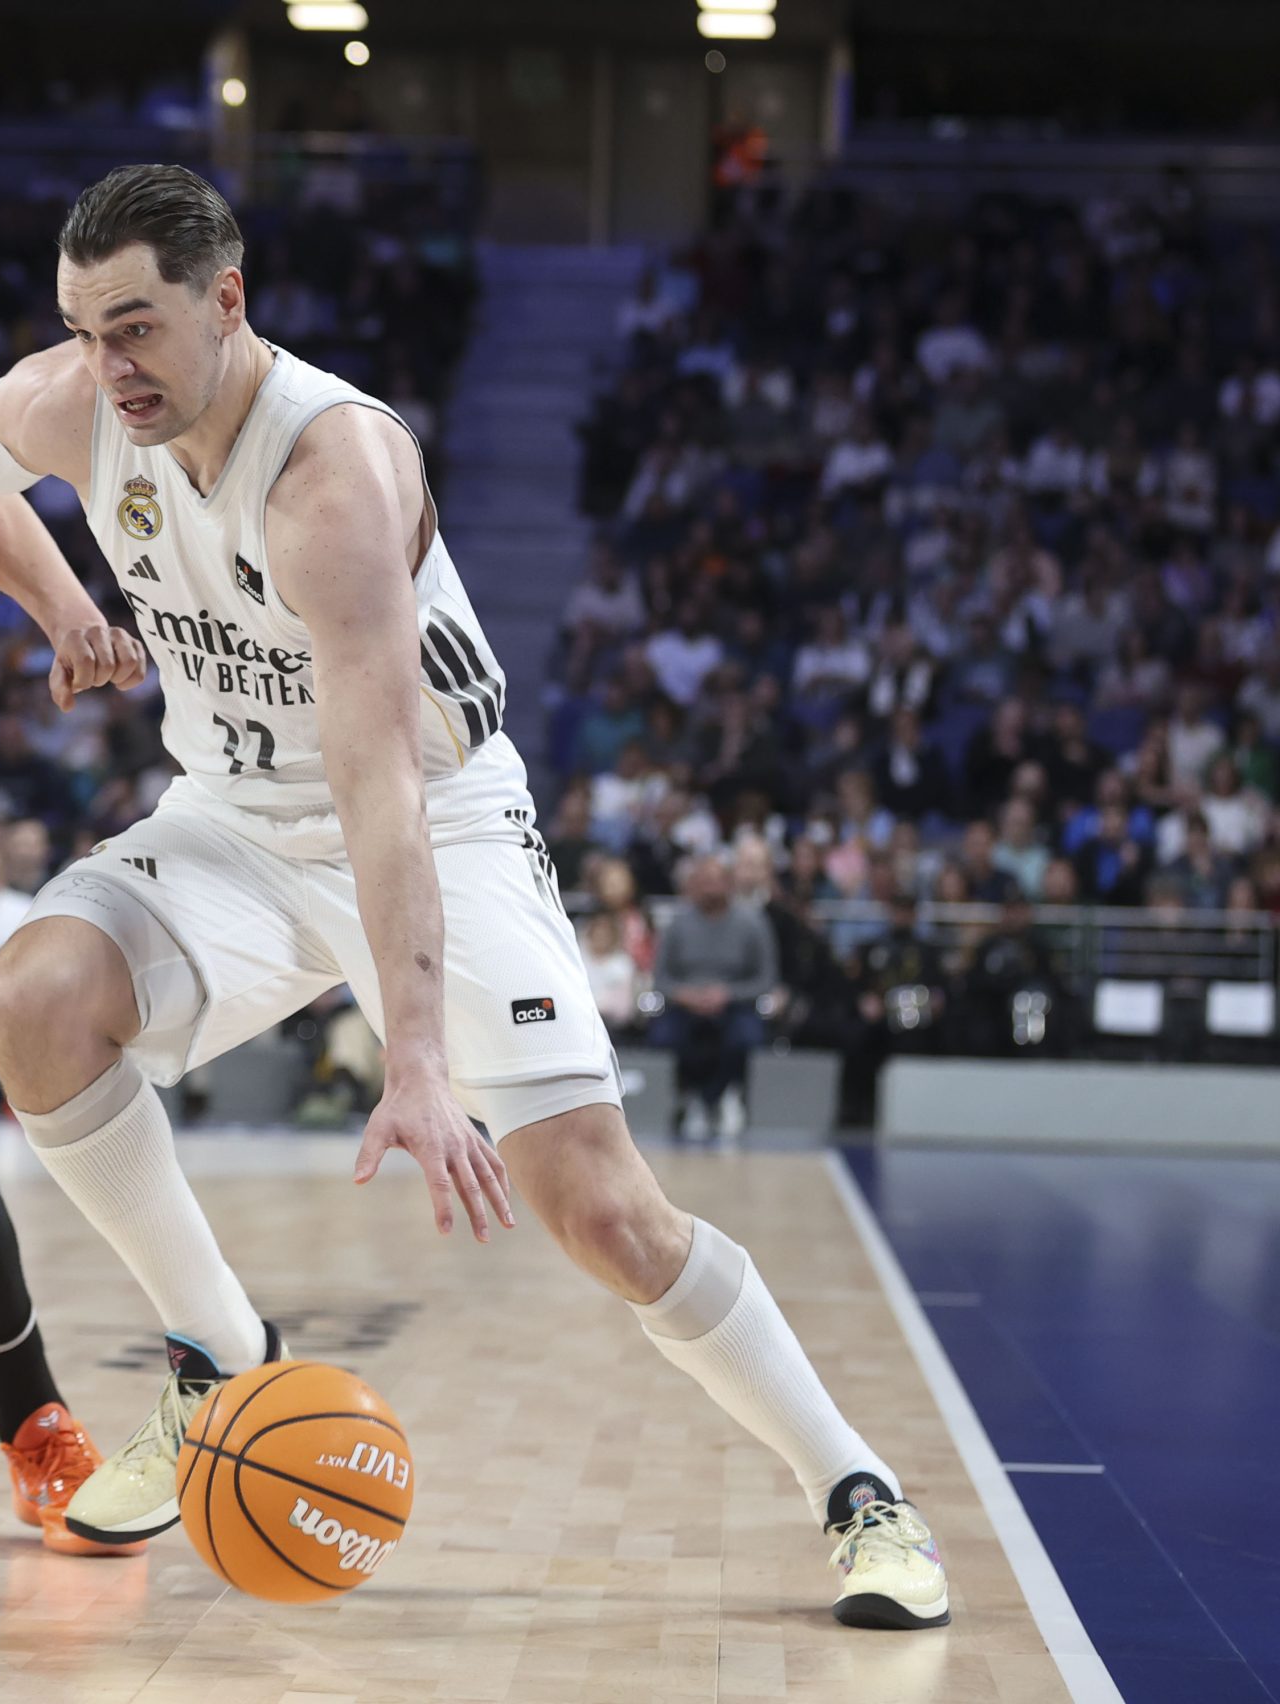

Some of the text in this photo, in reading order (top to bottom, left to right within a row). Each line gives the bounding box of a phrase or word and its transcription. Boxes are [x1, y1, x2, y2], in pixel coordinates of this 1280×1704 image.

[121, 587, 313, 675] Emiraes
[168, 648, 205, 688] LY
[515, 1006, 547, 1022] acb
[315, 1453, 347, 1468] NXT
[288, 1496, 398, 1574] Wilson
